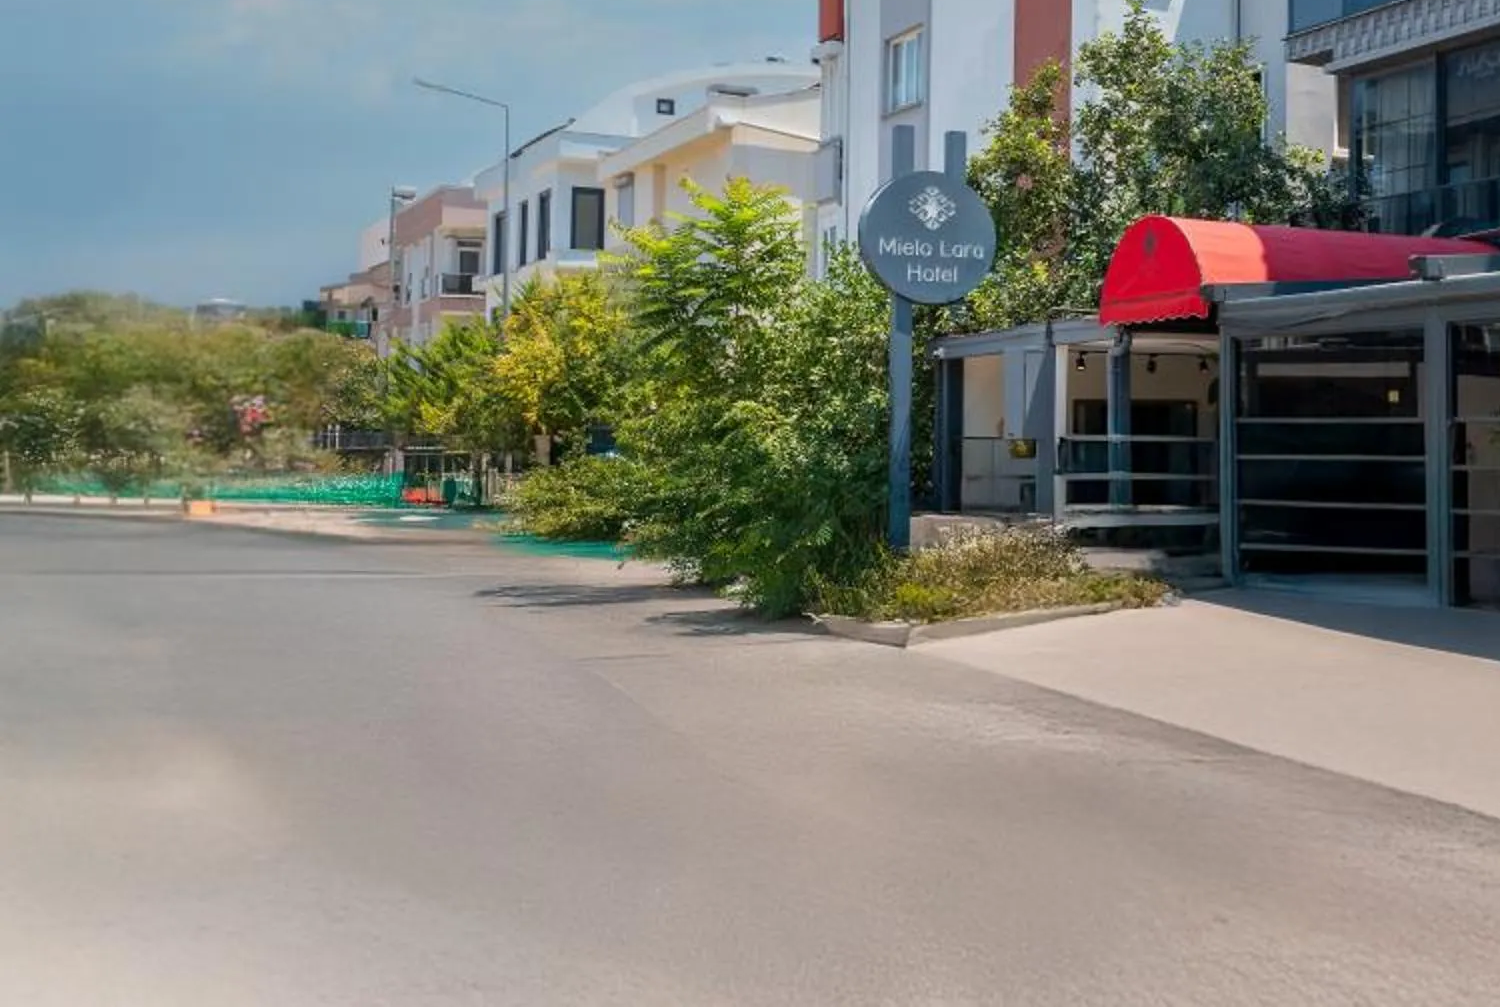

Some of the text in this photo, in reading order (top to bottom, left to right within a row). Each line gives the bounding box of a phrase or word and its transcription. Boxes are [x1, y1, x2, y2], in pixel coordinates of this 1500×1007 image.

[879, 237, 984, 259] Mielo Lara
[907, 263, 958, 283] Hotel
